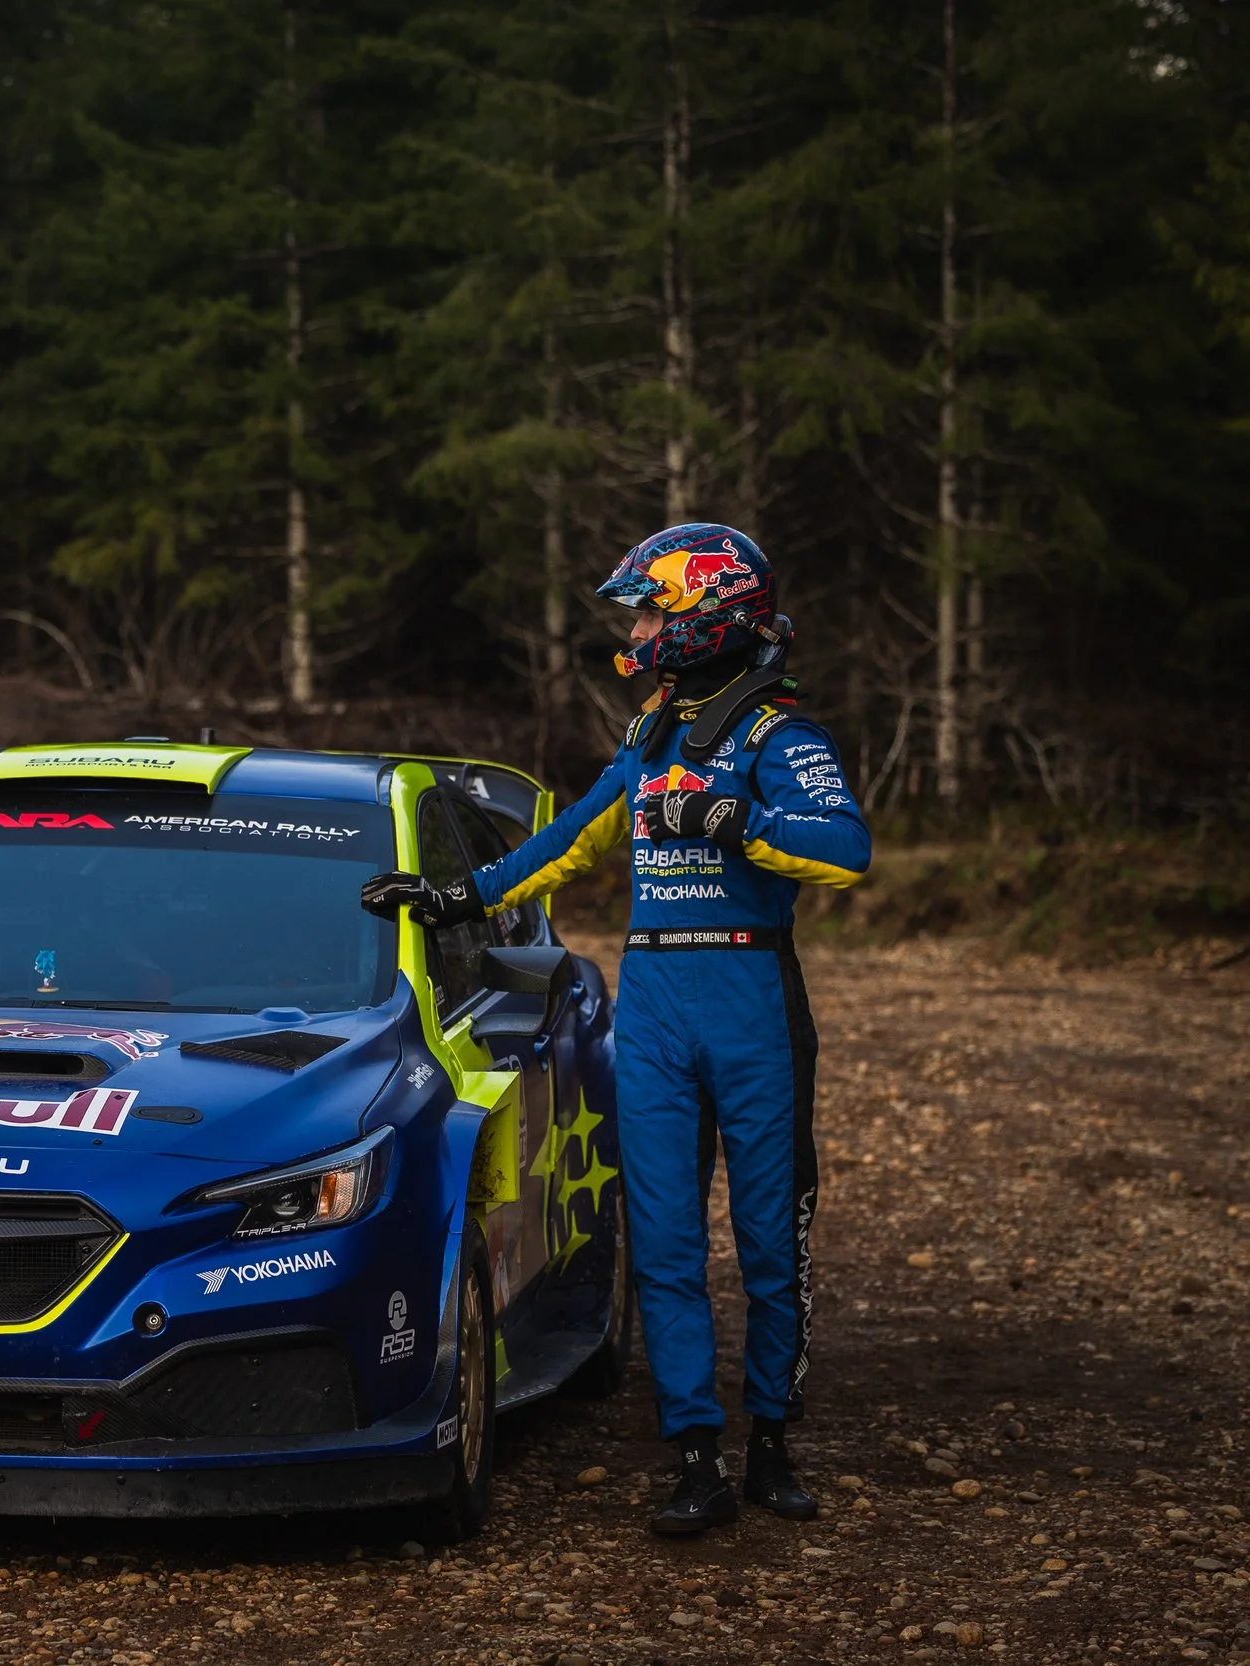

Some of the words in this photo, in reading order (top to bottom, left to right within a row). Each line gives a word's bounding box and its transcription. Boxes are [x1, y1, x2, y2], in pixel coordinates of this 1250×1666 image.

[716, 580, 740, 599] Red
[738, 573, 759, 592] Bull
[751, 713, 789, 744] sparco
[28, 757, 175, 765] SUBARU
[789, 752, 834, 769] DirtFis
[805, 777, 840, 787] MOTUL
[123, 815, 268, 830] AMERICAN
[276, 823, 360, 836] RALLY
[139, 824, 332, 842] ASSOCIATION
[634, 848, 723, 867] SUBARU
[699, 866, 723, 874] USA
[651, 884, 726, 900] YOKOHAMA
[659, 933, 694, 945] BRANDON
[693, 932, 730, 943] SEMENUK
[236, 1222, 307, 1238] TRIPLE-R
[230, 1249, 337, 1284] YOKOHAMA
[380, 1328, 415, 1358] R53
[379, 1350, 414, 1365] SUSPENSION
